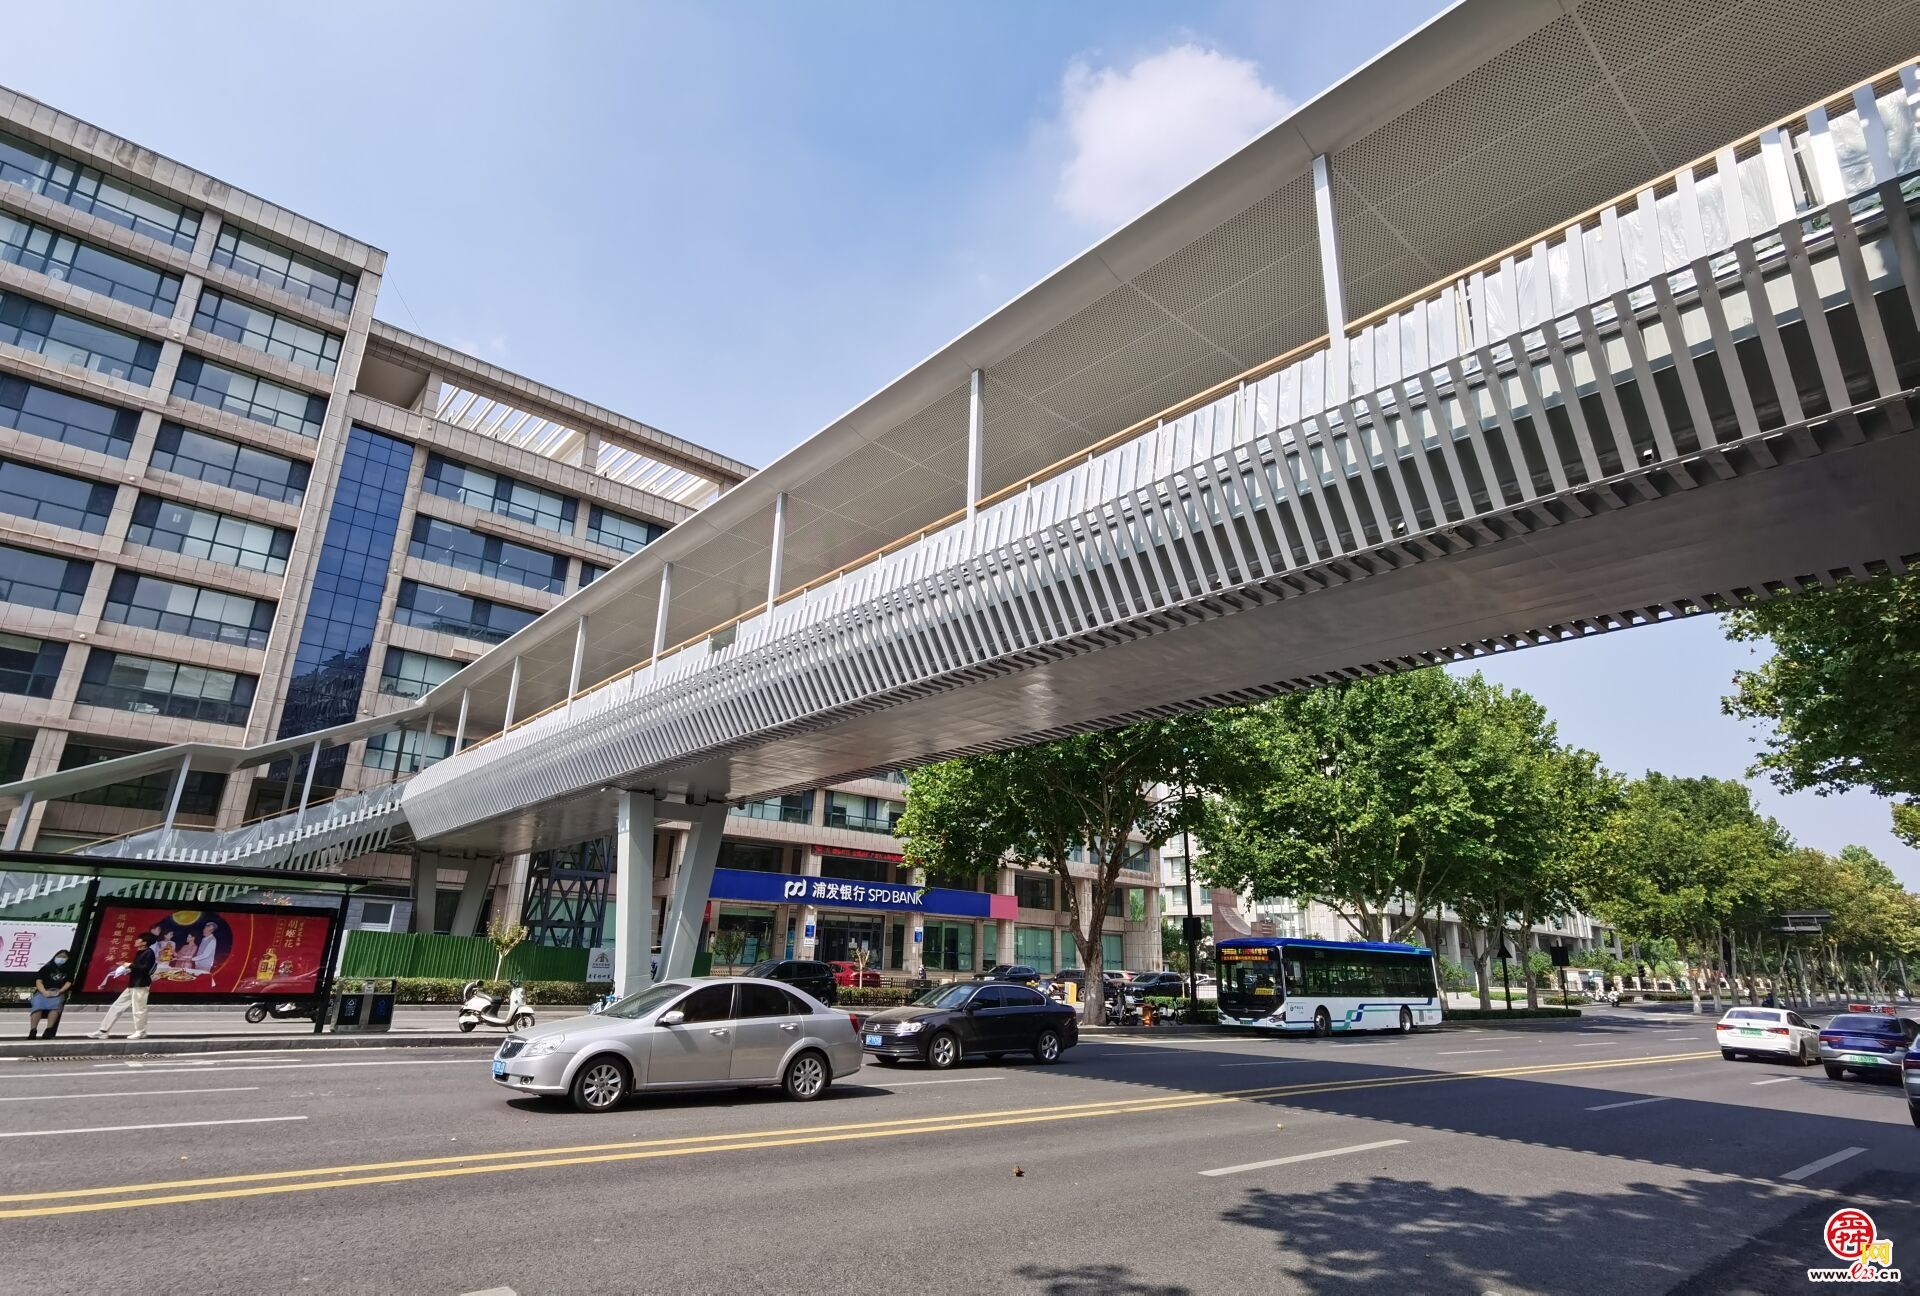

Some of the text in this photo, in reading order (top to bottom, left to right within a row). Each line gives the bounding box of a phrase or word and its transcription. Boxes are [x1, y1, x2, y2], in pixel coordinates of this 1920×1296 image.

[812, 882, 923, 905] 浦发银行 SPD BANK
[5, 930, 37, 968] 富强
